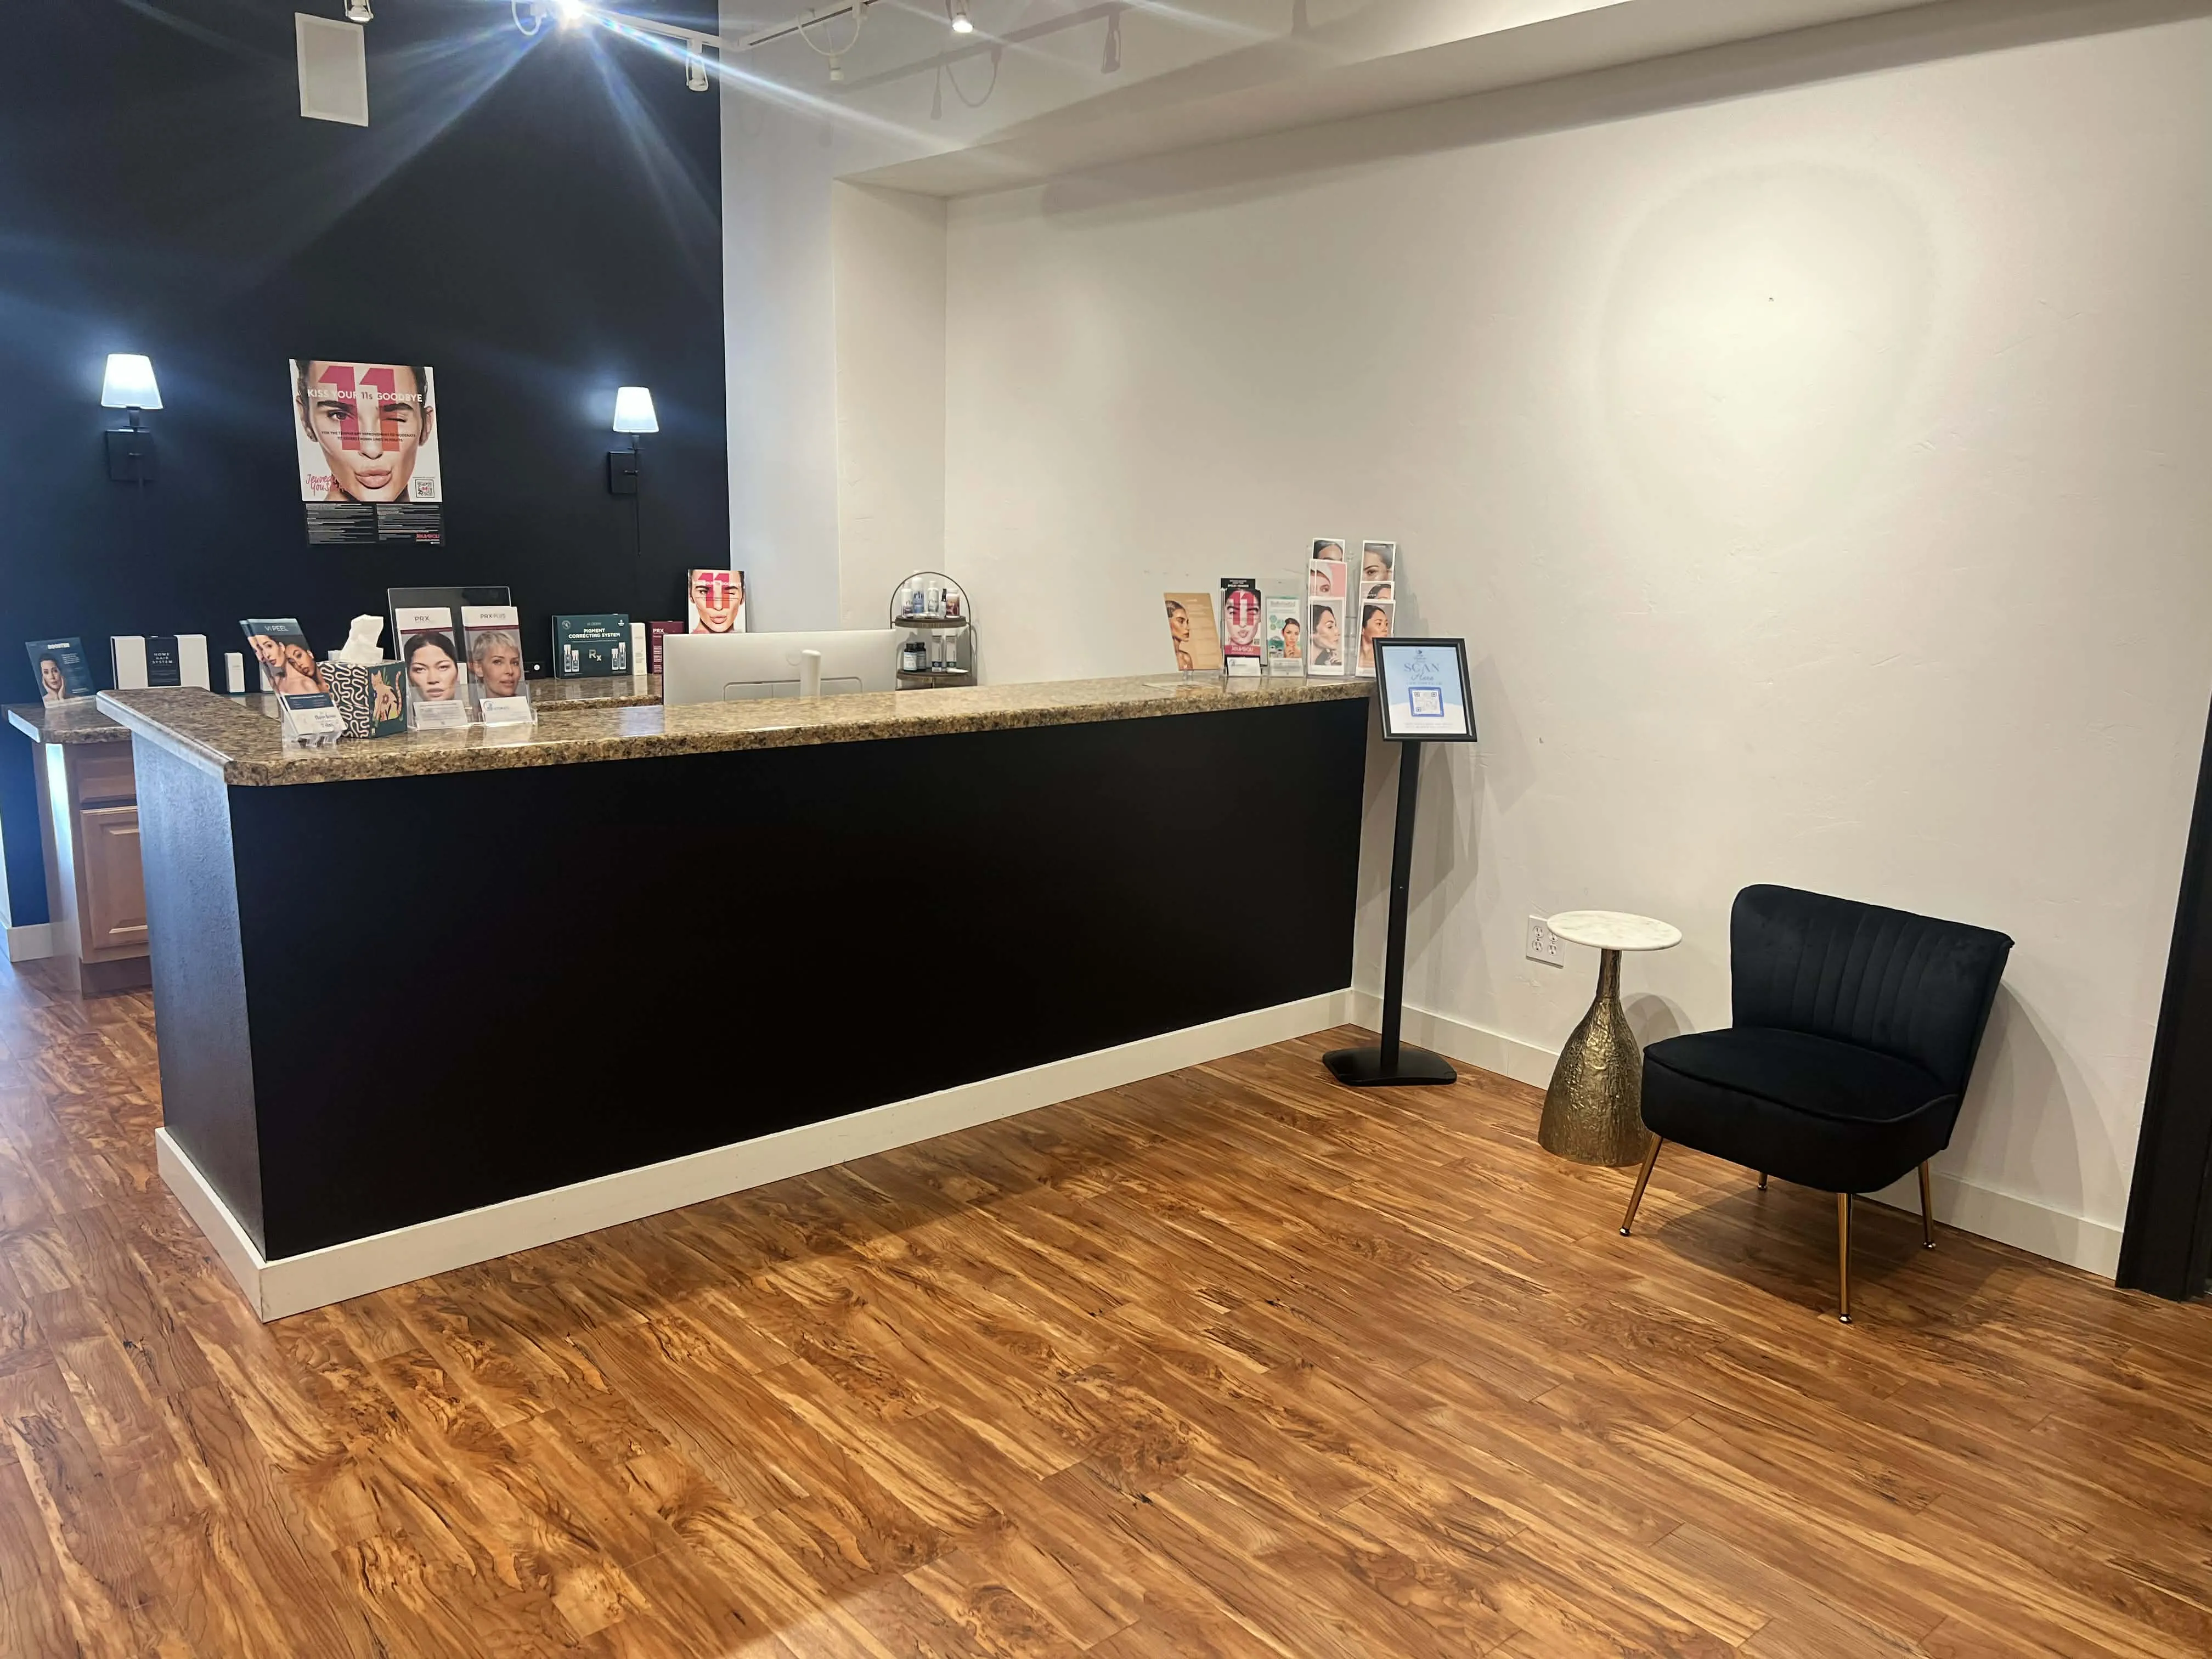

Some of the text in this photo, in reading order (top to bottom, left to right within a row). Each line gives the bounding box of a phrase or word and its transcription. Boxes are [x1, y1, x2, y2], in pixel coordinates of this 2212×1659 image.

[307, 389, 329, 398] KISS
[332, 390, 357, 399] YOUR
[377, 392, 423, 402] GOODBYE
[1404, 662, 1440, 673] SCAN
